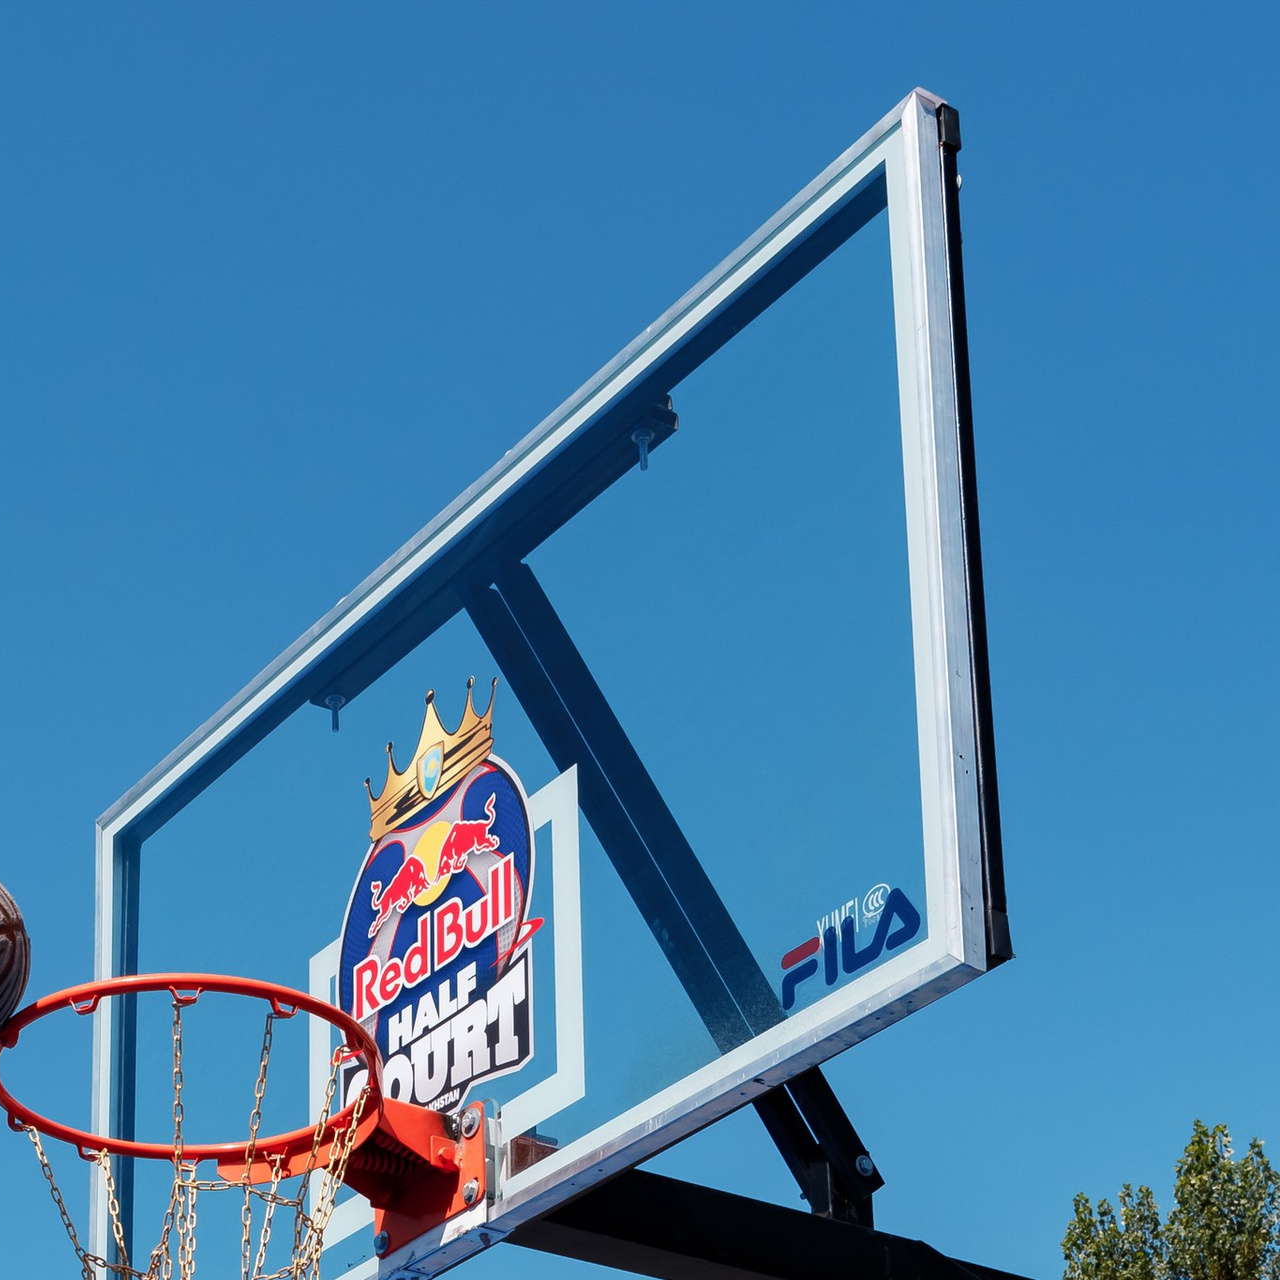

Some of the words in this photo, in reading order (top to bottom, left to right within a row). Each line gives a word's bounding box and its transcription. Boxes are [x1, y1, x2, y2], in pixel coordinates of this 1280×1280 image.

[354, 910, 429, 1024] Red
[434, 855, 515, 972] Bull
[781, 888, 921, 1011] FILA
[388, 961, 478, 1056] HALF
[424, 1087, 460, 1111] KHSTAN
